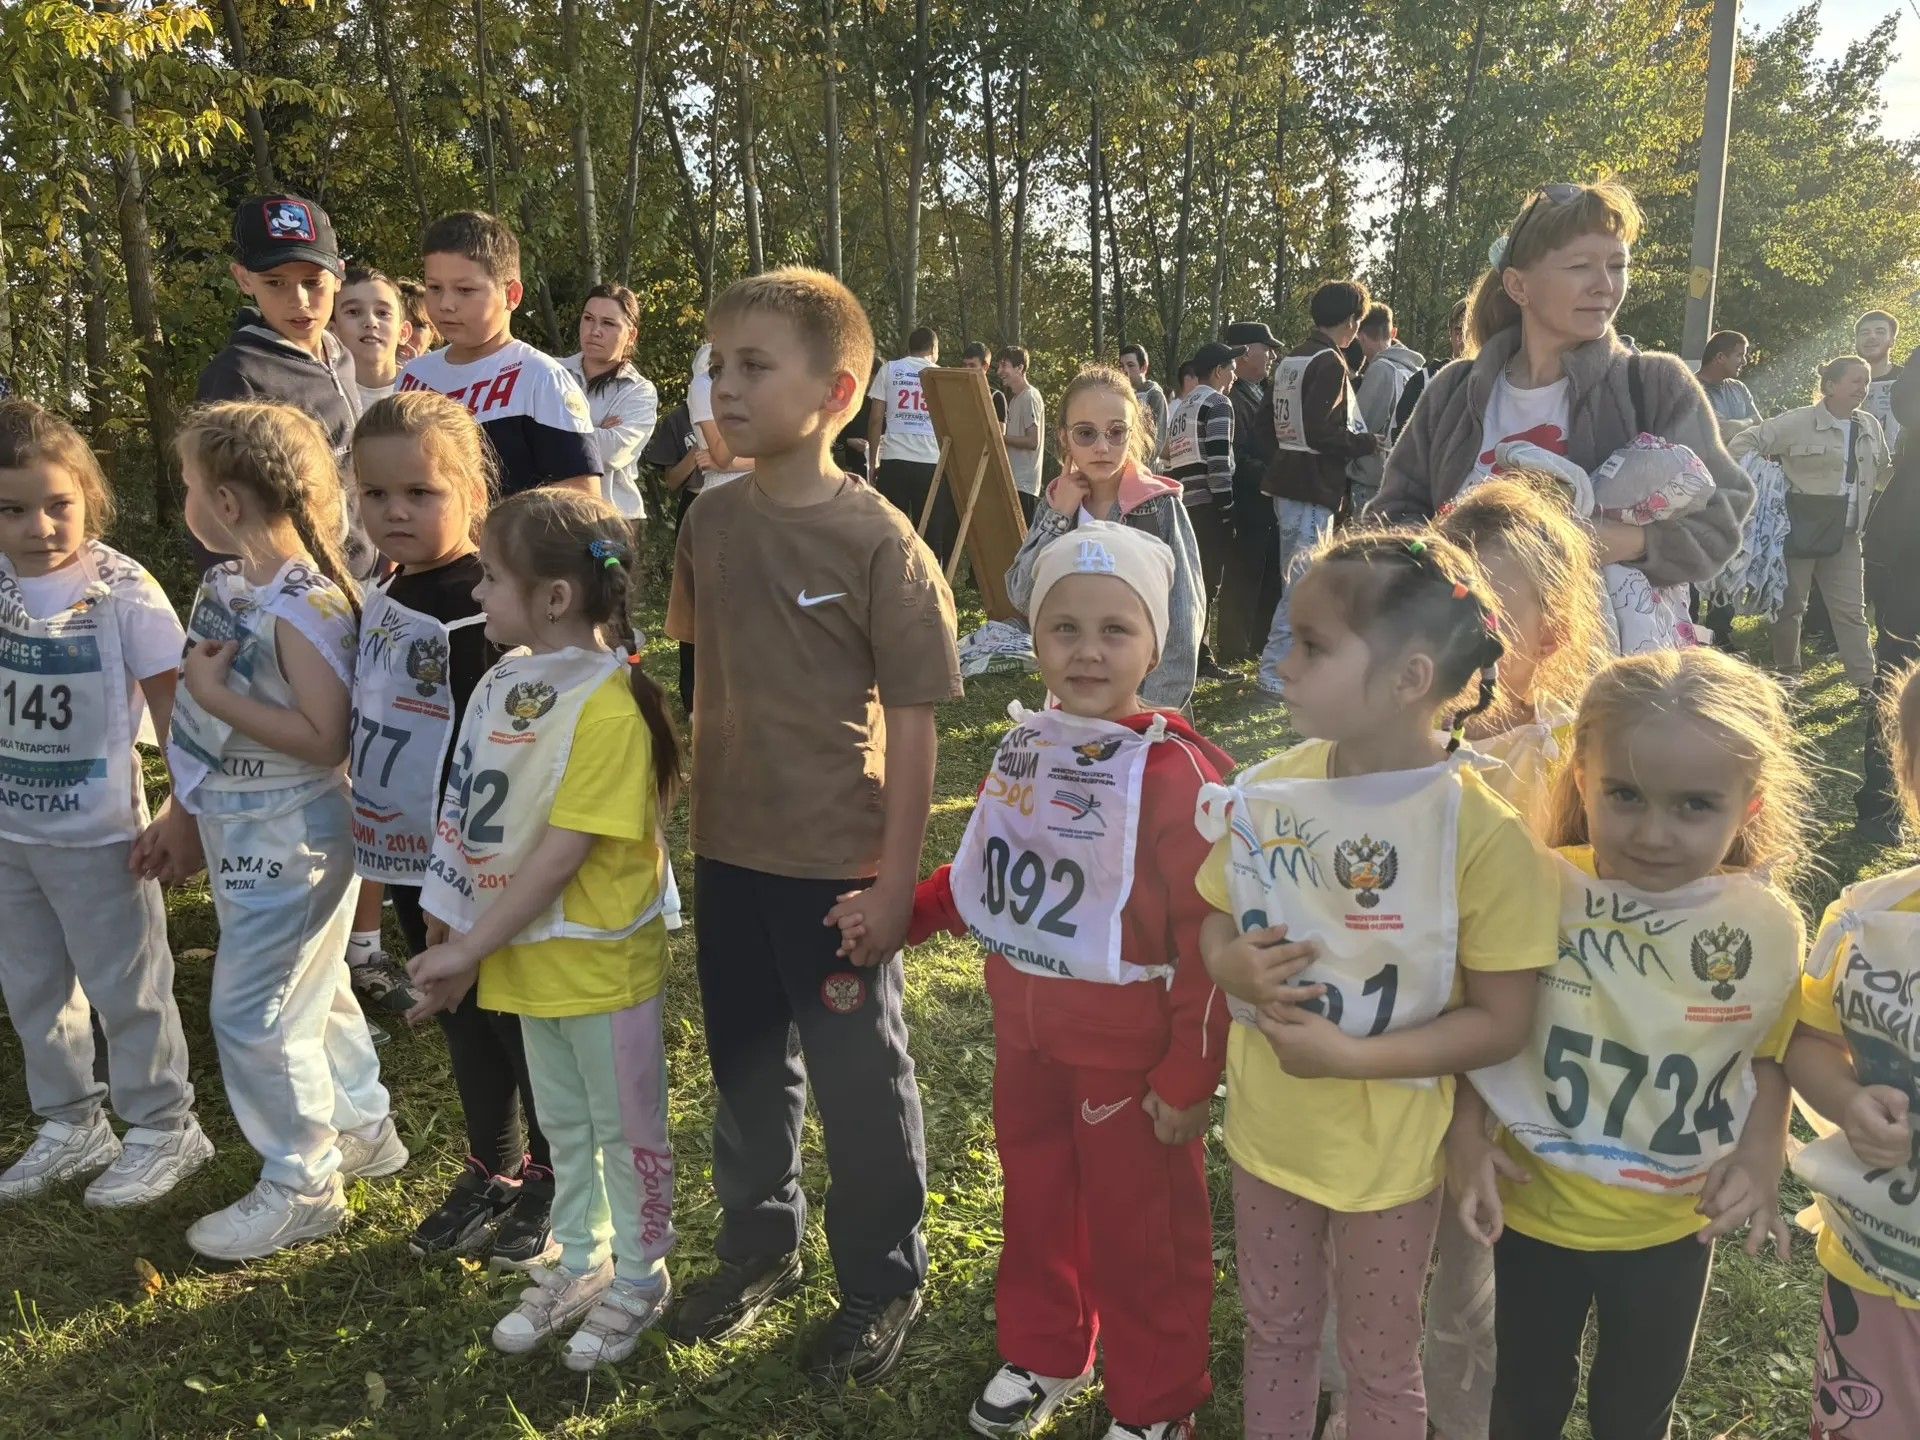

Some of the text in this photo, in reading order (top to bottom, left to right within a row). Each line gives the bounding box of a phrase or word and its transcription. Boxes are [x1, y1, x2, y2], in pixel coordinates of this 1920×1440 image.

[1077, 540, 1115, 572] LA
[4, 680, 73, 730] 143
[15, 741, 70, 754] ТАТАРСТАН
[386, 833, 428, 854] 2014
[220, 856, 283, 878] AMA'S
[226, 880, 256, 889] MINI
[478, 873, 514, 889] 201
[980, 836, 1085, 938] 092
[1543, 1024, 1742, 1156] 5724
[633, 1146, 672, 1246] Barbie
